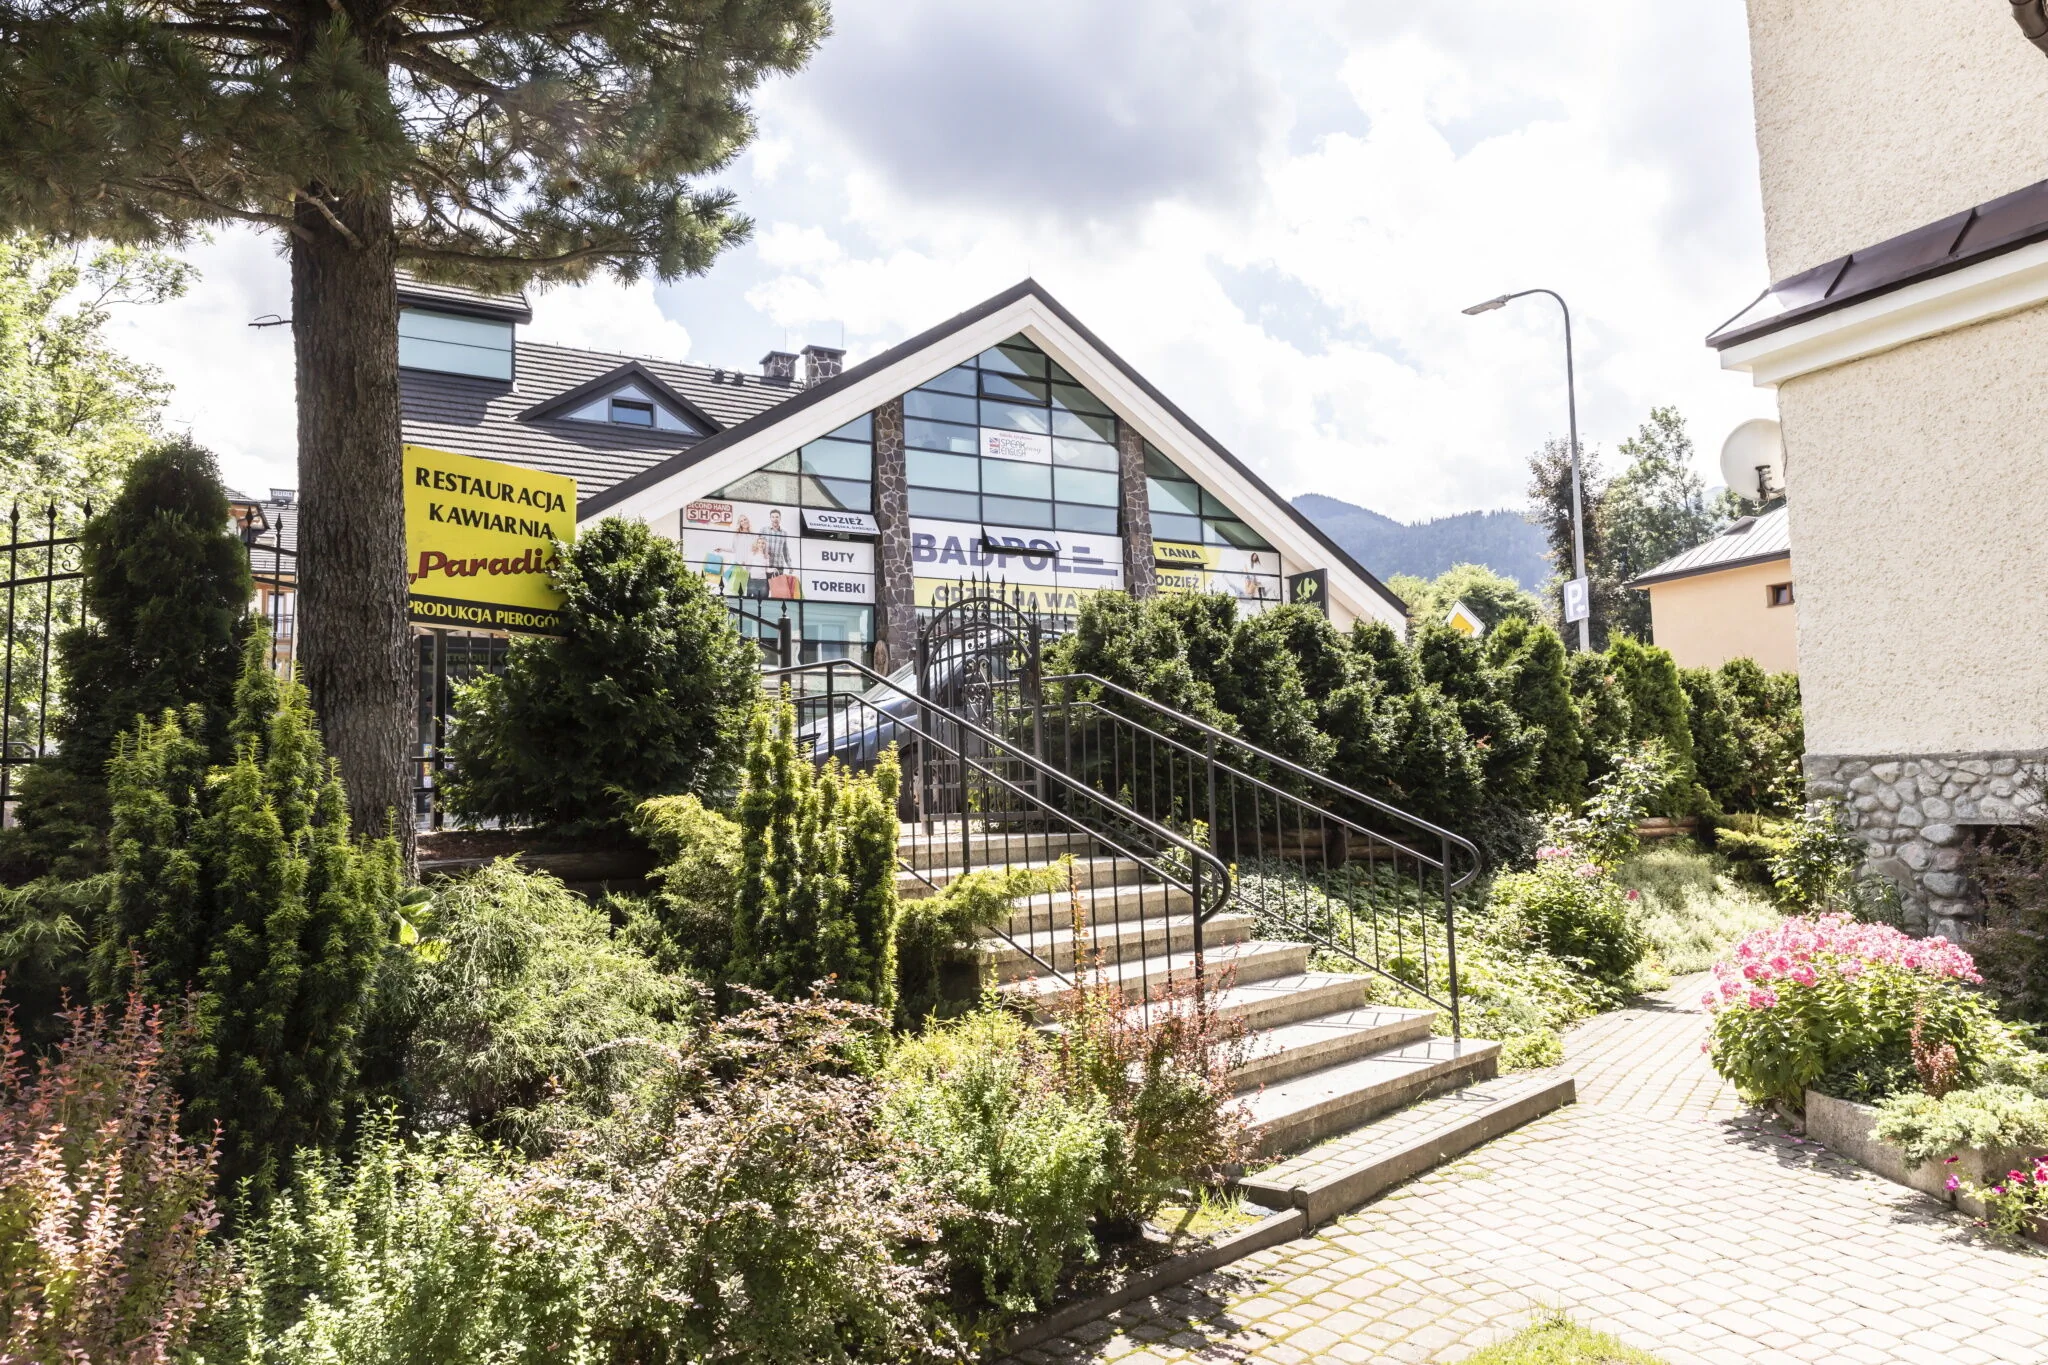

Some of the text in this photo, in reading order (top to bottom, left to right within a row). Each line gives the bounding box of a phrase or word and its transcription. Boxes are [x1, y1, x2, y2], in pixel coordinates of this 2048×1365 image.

[415, 467, 566, 513] RESTAURACJA
[429, 503, 558, 540] KAWIARNIA
[689, 509, 731, 521] SHOP
[818, 514, 864, 526] ODZIEŻ
[821, 550, 855, 563] BUTY
[912, 532, 1071, 573] BADPOL
[1160, 547, 1200, 560] TANIA
[812, 580, 866, 594] TOREBKI
[1156, 573, 1200, 589] ODZIEŻ
[1045, 592, 1077, 609] WA
[1567, 583, 1582, 617] P
[408, 600, 561, 628] PRODUKCJA PIEROGÓ
